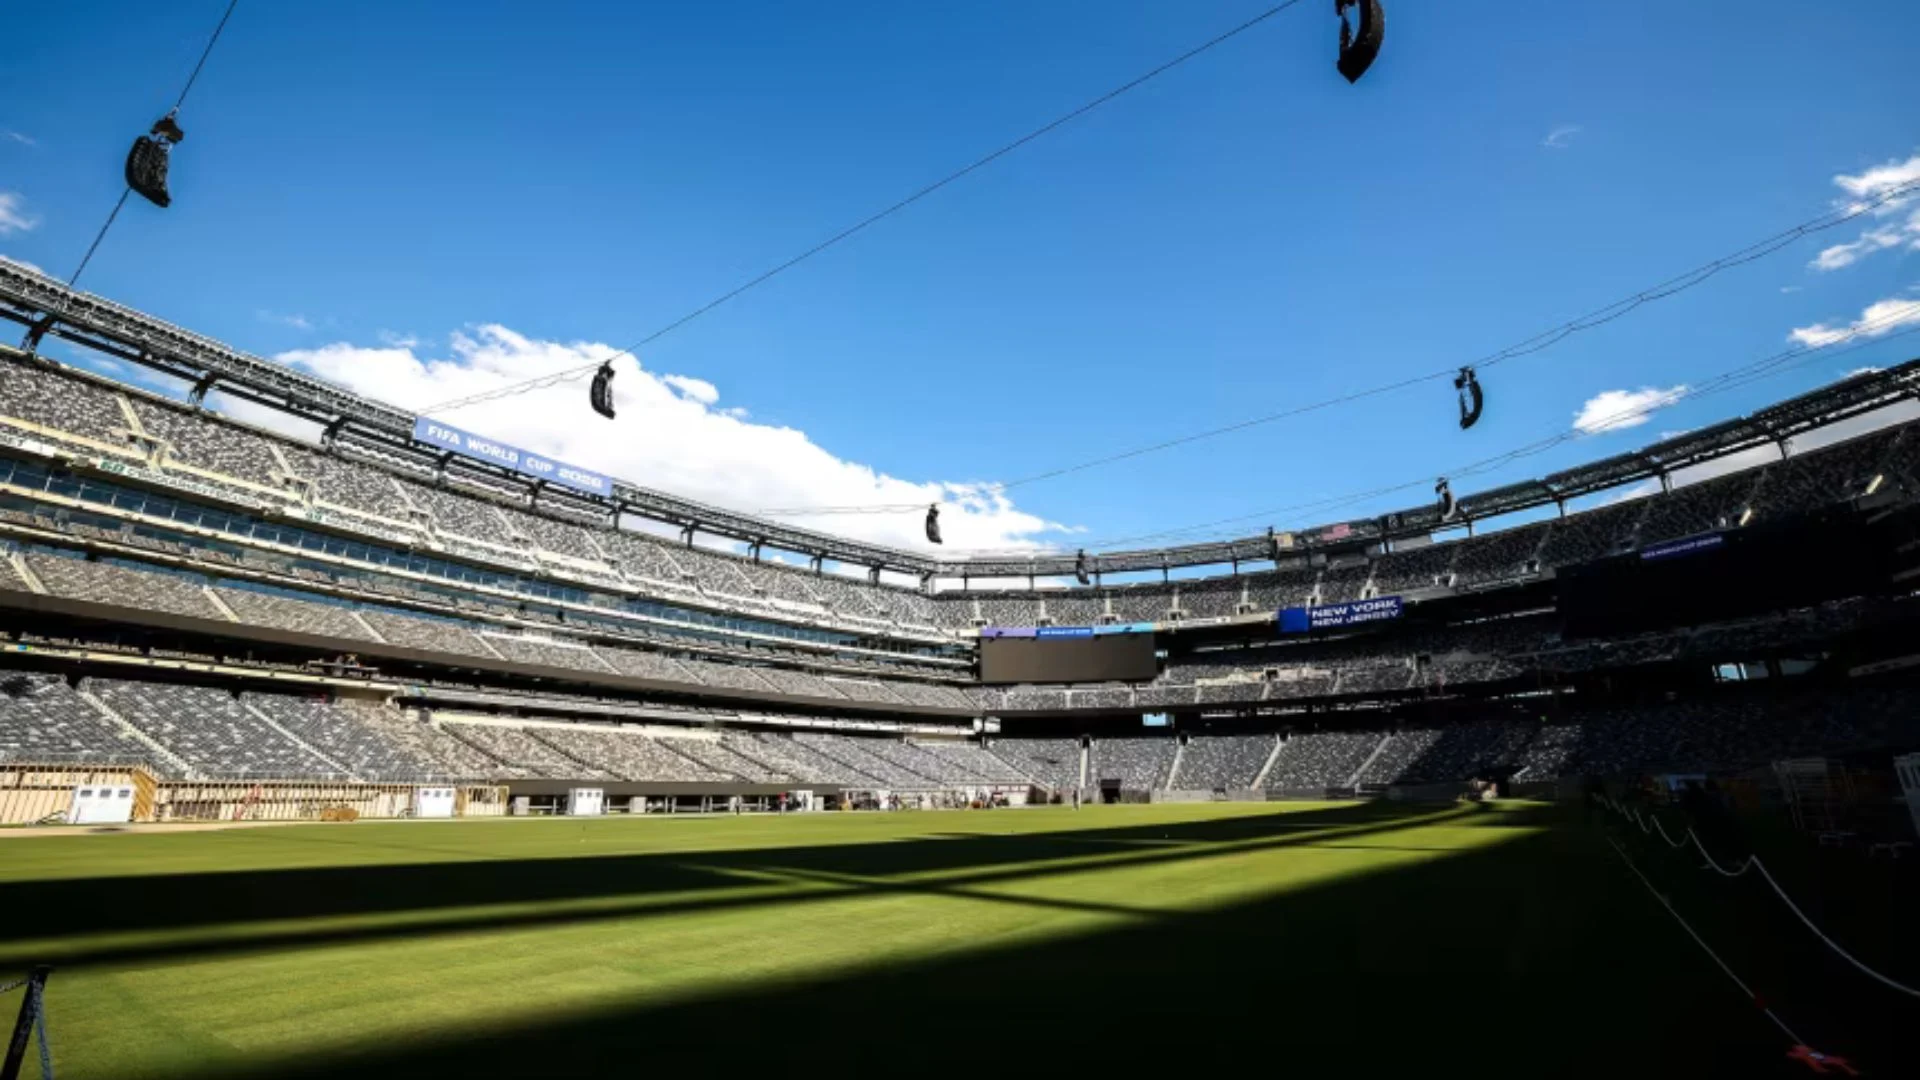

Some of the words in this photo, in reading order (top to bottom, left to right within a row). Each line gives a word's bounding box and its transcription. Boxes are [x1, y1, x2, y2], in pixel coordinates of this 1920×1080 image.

[428, 424, 460, 445] FIFA
[467, 438, 519, 463] WORLD
[527, 457, 553, 473] CUP
[1312, 606, 1348, 619] NEW
[1352, 600, 1398, 613] YORK
[1312, 617, 1343, 627] NEW
[1346, 609, 1398, 623] JERSEY
